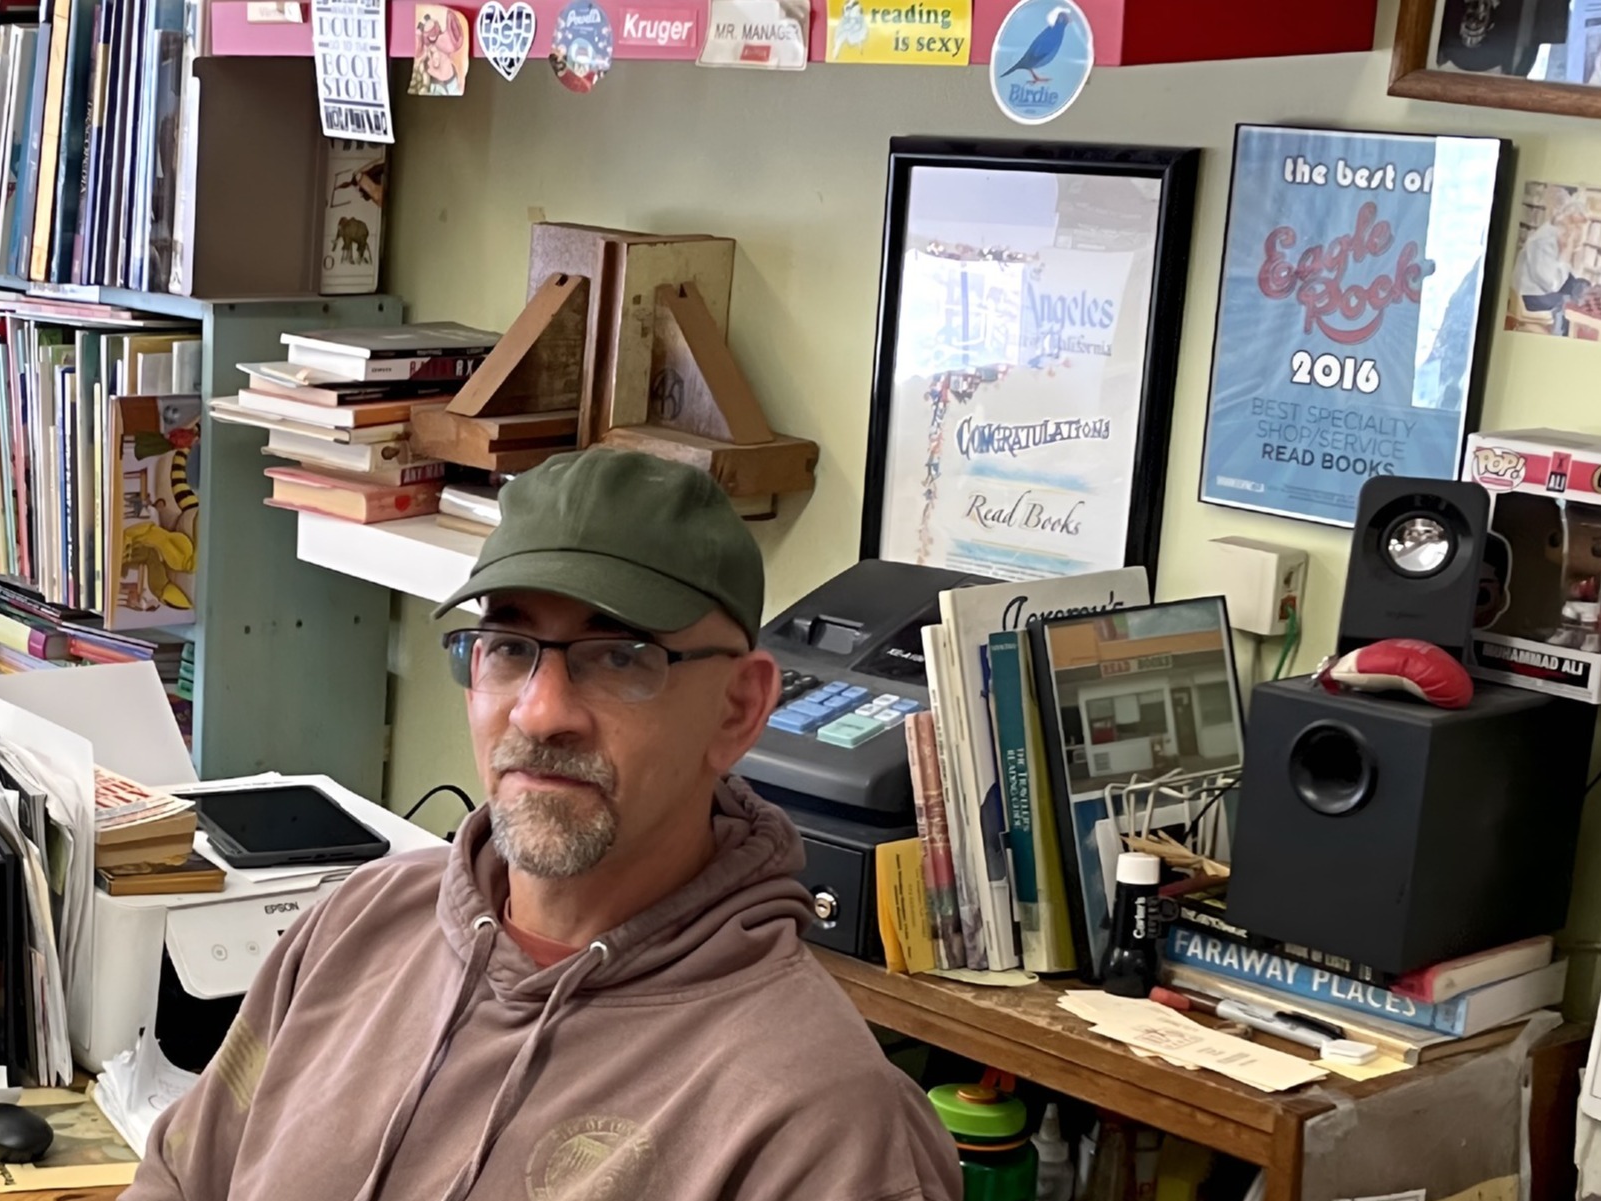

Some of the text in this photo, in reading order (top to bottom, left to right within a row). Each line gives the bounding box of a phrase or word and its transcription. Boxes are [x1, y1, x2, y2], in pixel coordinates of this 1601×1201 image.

[318, 16, 379, 40] DOUBT
[623, 12, 693, 46] Kruger
[715, 23, 735, 41] MR.
[870, 5, 952, 30] reading
[894, 31, 964, 58] is sexy
[321, 53, 380, 80] BOOK
[323, 77, 381, 101] STORE
[1009, 83, 1059, 106] Birdie
[1283, 155, 1329, 186] the
[1335, 158, 1396, 191] best
[1258, 201, 1394, 299] Eagle
[1296, 241, 1423, 345] Rock
[1290, 349, 1381, 394] 2016
[1251, 397, 1417, 439] BEST SPECIALTY
[1255, 419, 1407, 461] SHOP/SERVICE
[1261, 443, 1395, 478] READ BOOKS
[1474, 448, 1525, 480] POP!
[1548, 475, 1567, 491] ALI
[965, 490, 1085, 536] Read Books
[1482, 642, 1585, 676] MUHAMMAD ALI
[264, 901, 300, 915] EPSON
[1174, 929, 1417, 1018] FARAWAY PLACES
